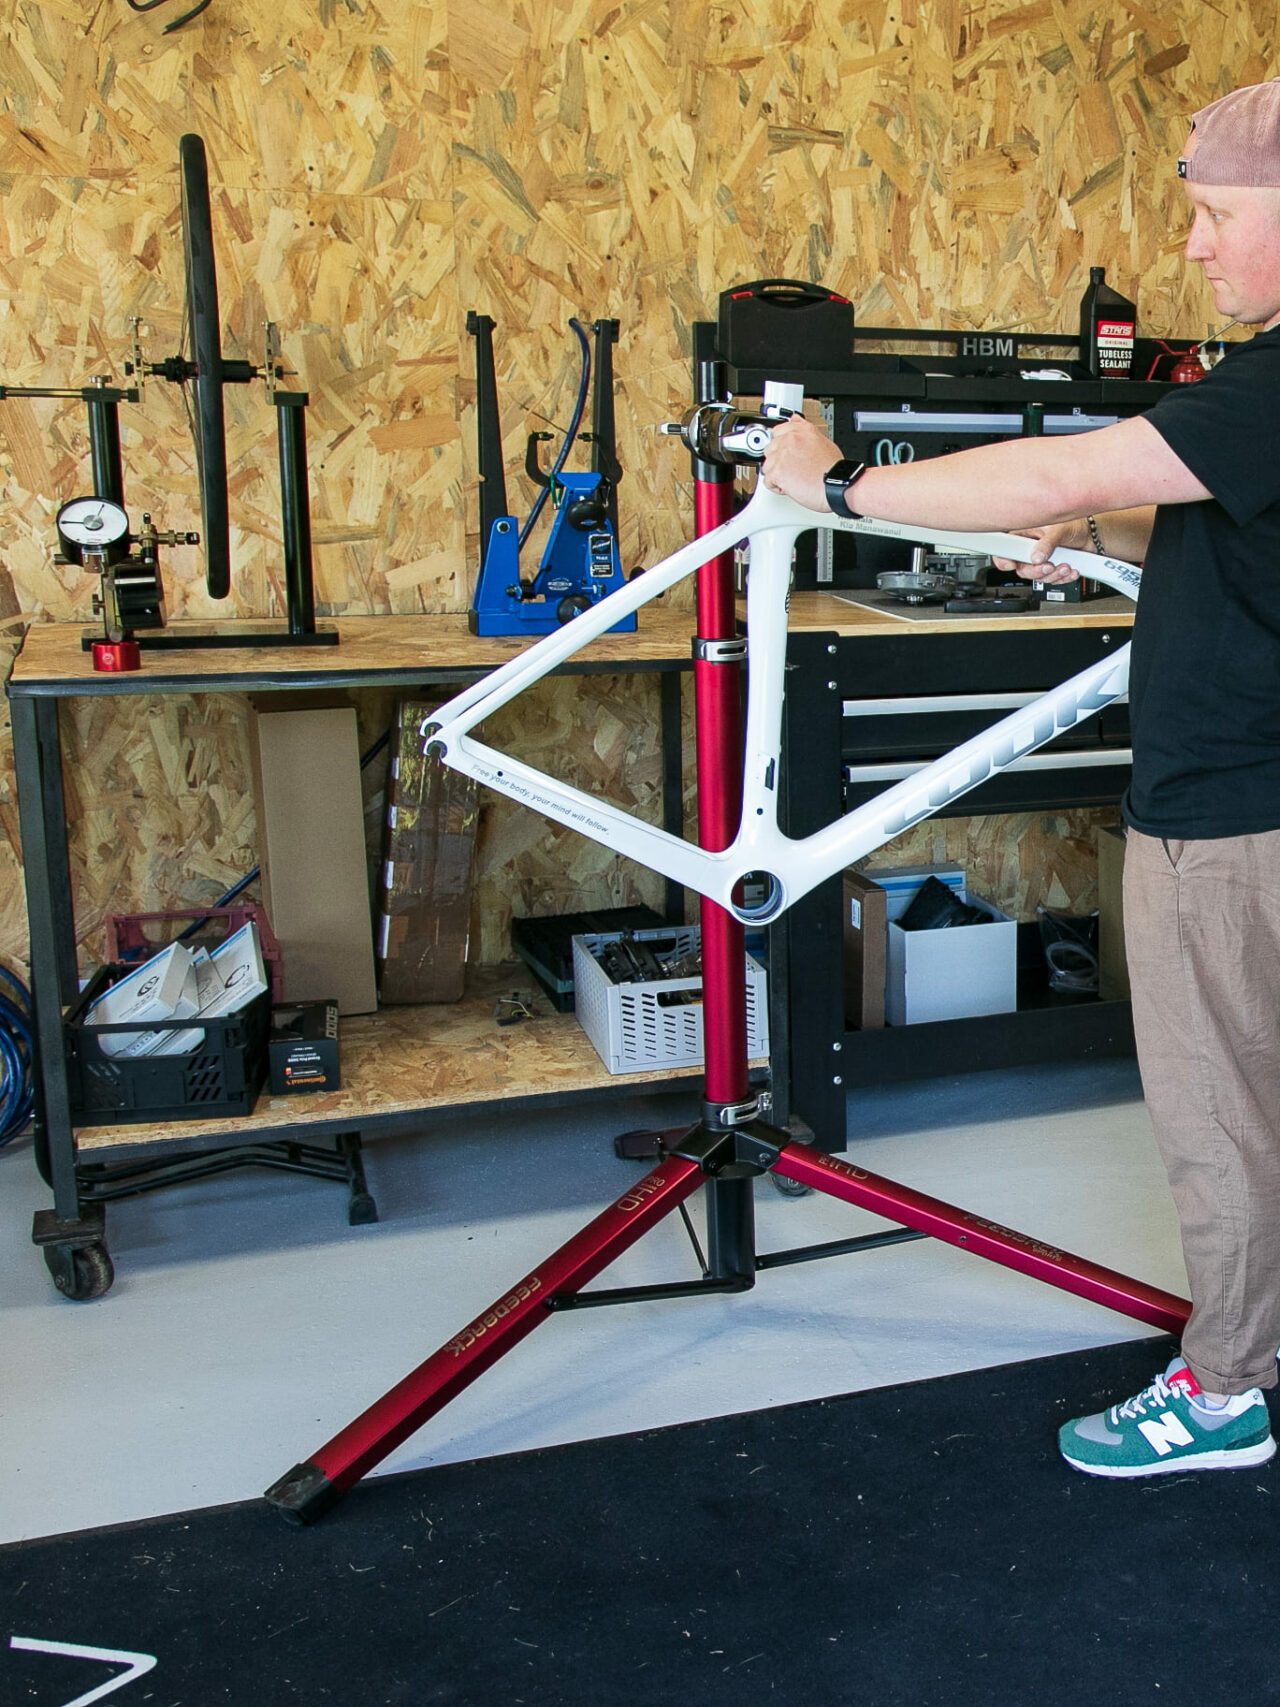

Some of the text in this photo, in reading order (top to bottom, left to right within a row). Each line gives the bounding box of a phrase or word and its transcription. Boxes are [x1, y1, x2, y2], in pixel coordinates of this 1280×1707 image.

[963, 337, 1014, 357] HBM
[1099, 349, 1132, 360] TUBELESS
[1099, 359, 1131, 369] SEALANT
[471, 764, 489, 777] Free
[490, 774, 509, 787] your
[510, 782, 530, 798] body,
[531, 794, 551, 806] your
[551, 801, 572, 815] mind
[571, 811, 586, 822] will
[617, 1184, 654, 1211] HD
[453, 1277, 542, 1357] FEEDBACK
